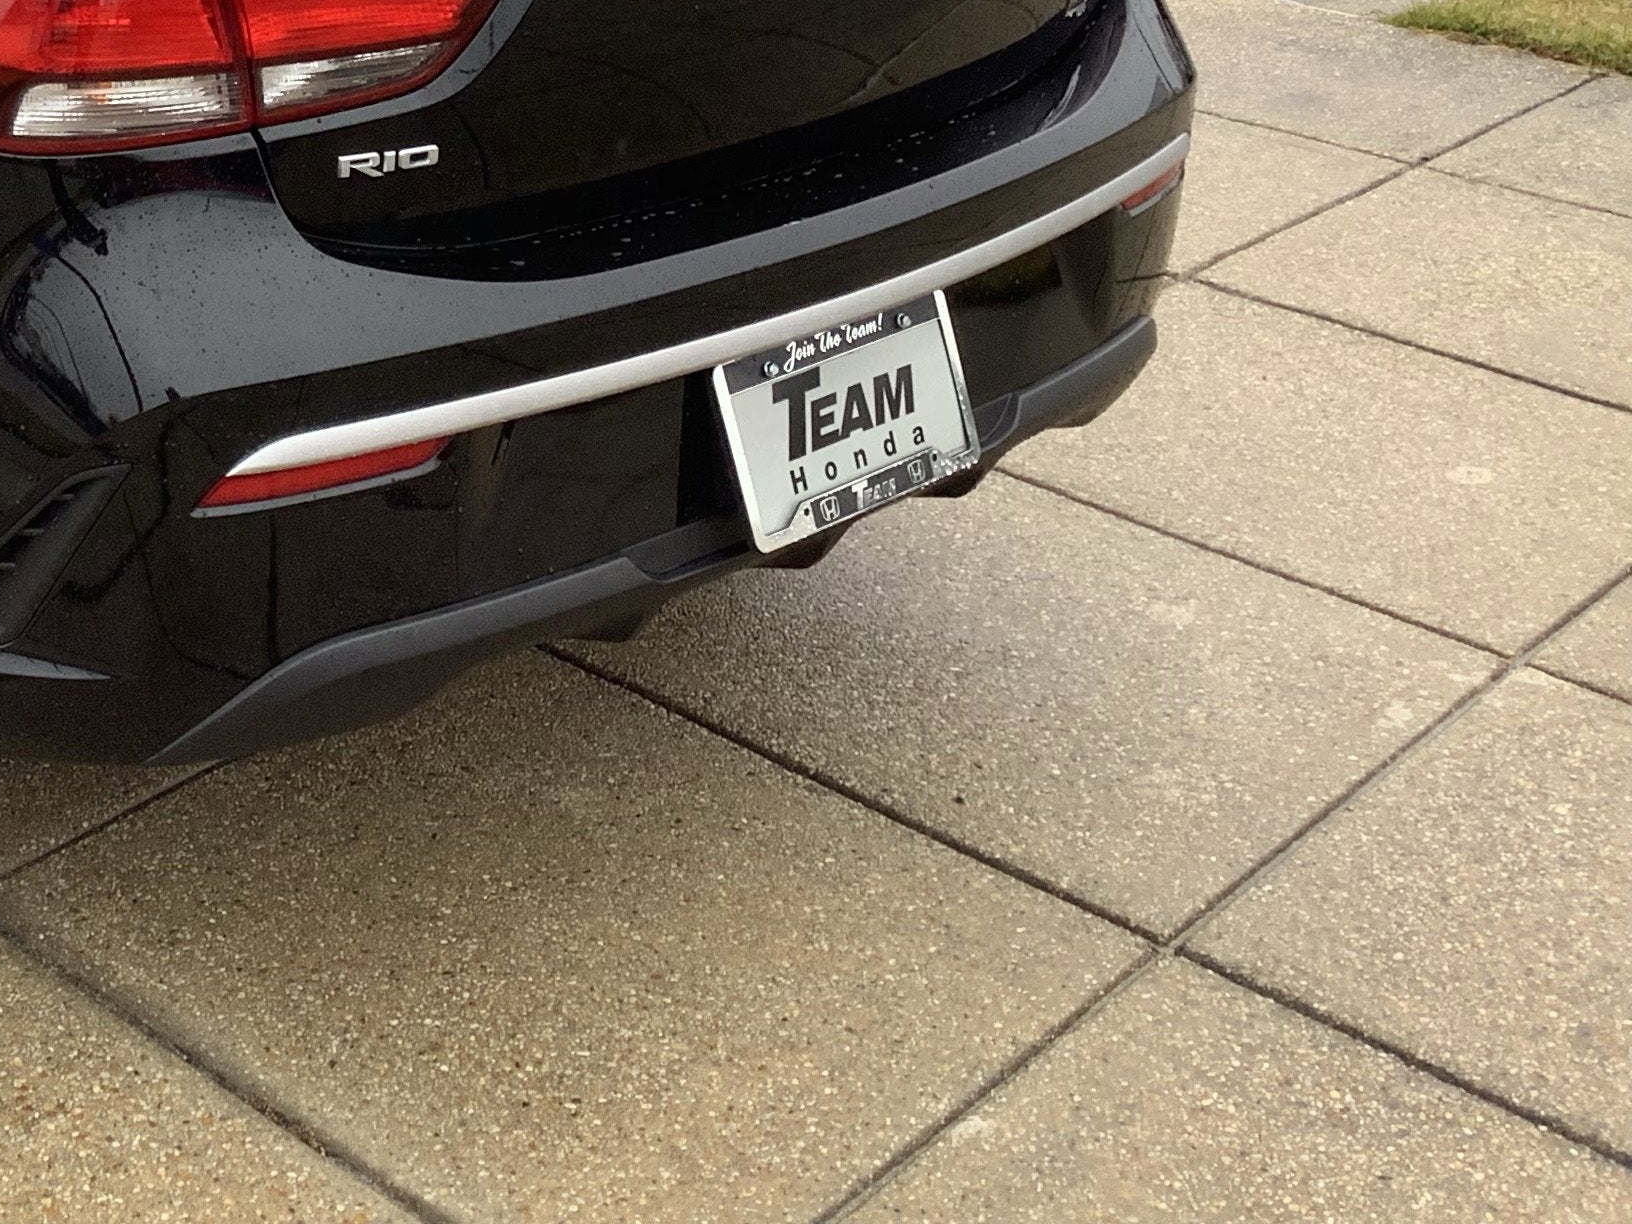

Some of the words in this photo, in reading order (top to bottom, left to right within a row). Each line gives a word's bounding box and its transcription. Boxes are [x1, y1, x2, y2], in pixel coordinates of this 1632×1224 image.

[337, 144, 439, 178] RIO
[783, 340, 817, 373] Join
[815, 330, 842, 350] The
[840, 312, 883, 343] Team!
[772, 363, 915, 462] TEAM
[789, 425, 926, 496] Honda
